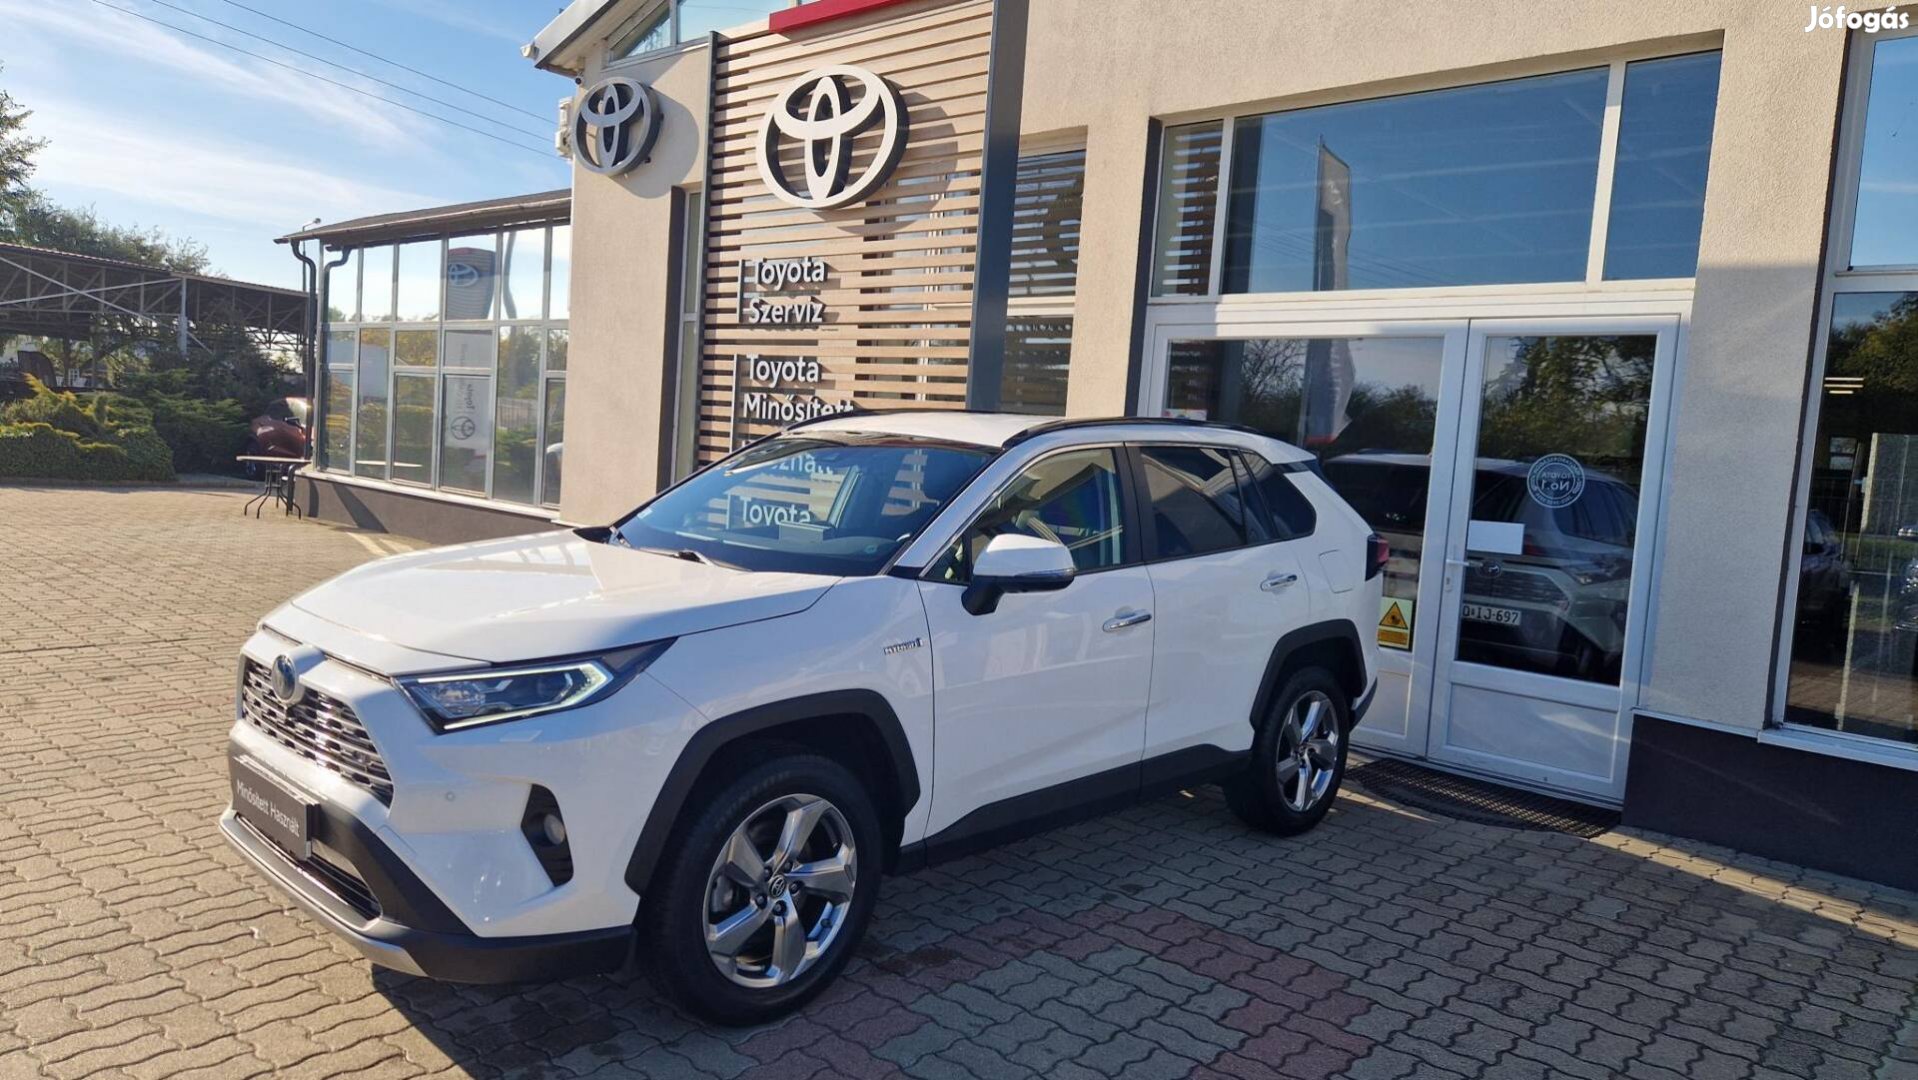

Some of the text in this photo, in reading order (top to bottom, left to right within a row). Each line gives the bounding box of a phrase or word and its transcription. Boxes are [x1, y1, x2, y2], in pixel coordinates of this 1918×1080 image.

[752, 257, 825, 291] Toyota
[748, 296, 824, 323] Szerviz
[746, 353, 819, 388] Toyota
